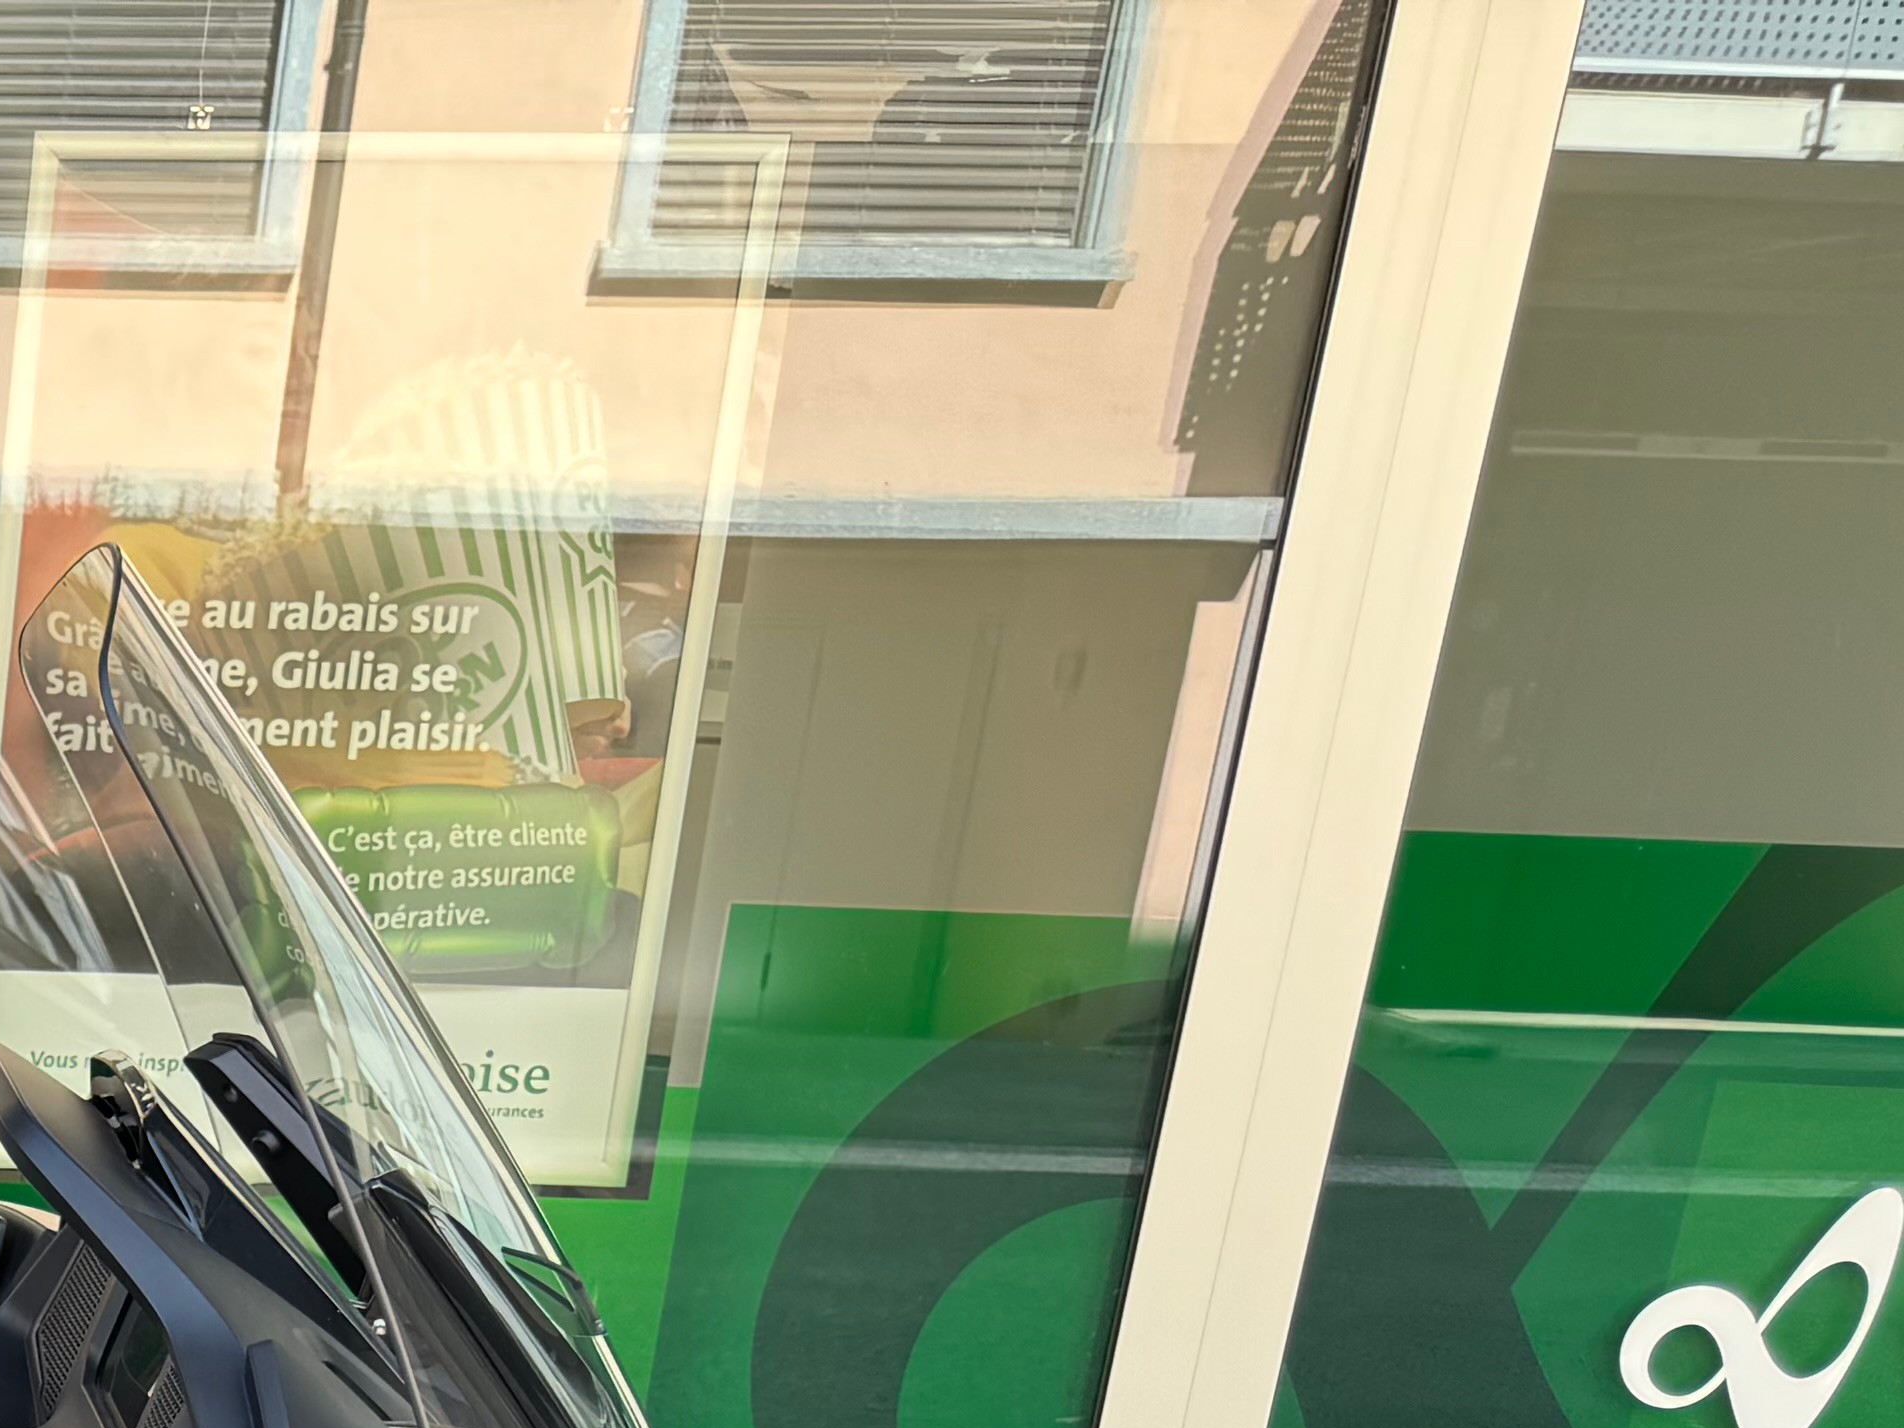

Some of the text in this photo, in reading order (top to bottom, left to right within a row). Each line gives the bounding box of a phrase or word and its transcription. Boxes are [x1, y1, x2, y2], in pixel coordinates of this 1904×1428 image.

[202, 600, 255, 631] au
[267, 590, 399, 633] rabais
[410, 604, 479, 635] sur
[45, 668, 88, 698] sa
[272, 649, 399, 692] Giulia
[410, 663, 458, 693] se
[46, 711, 115, 754] fait
[347, 709, 492, 761] plaisir.
[328, 821, 588, 857] C'est ça, être cliente
[368, 866, 444, 892] notre
[450, 864, 576, 889] assurance
[373, 901, 492, 932] pérative.
[30, 1050, 79, 1069] Vous
